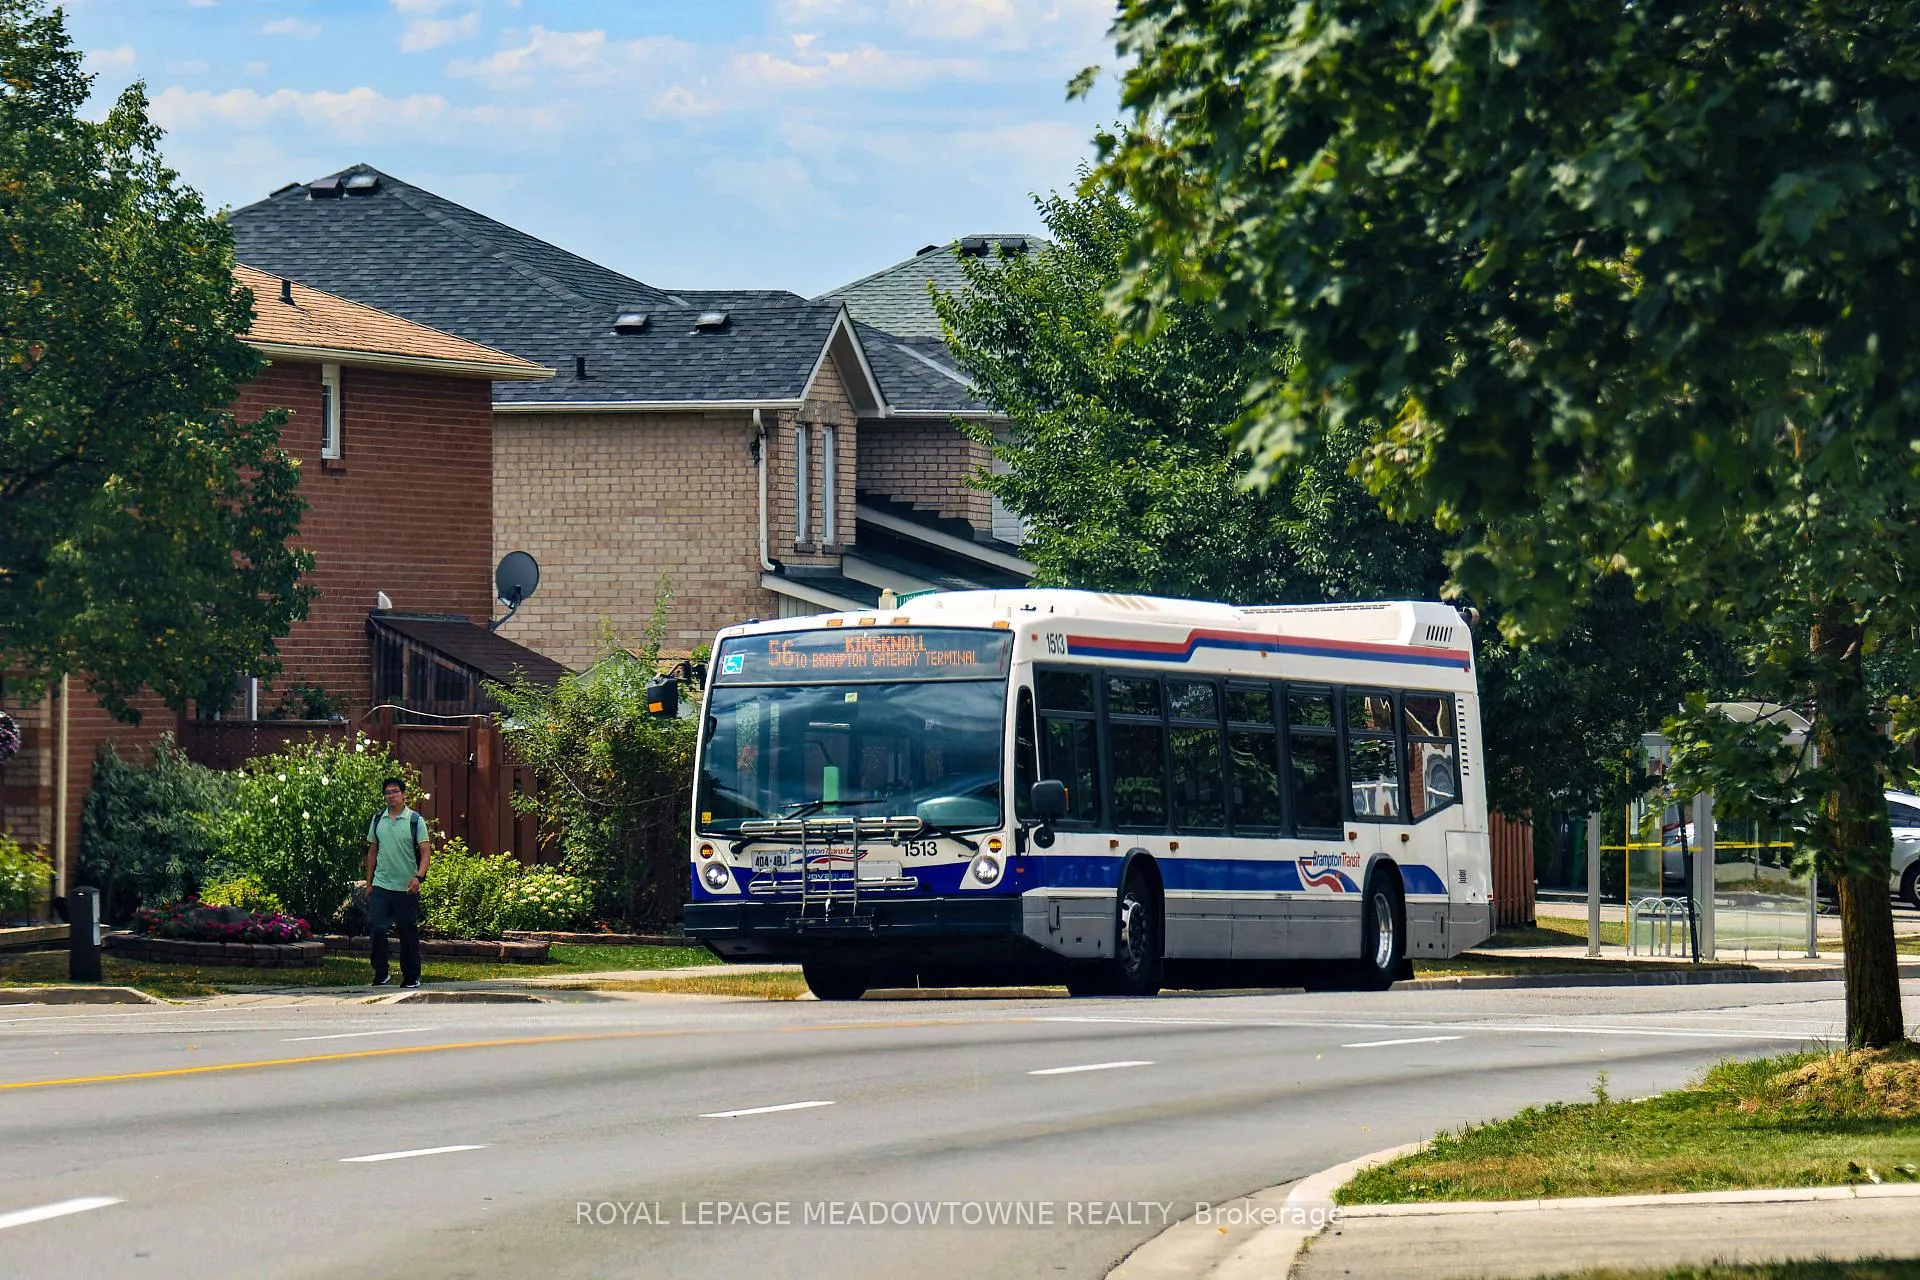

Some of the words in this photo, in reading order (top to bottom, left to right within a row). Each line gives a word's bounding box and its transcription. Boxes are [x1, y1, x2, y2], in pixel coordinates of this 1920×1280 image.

[845, 635, 926, 653] KINGKNOLL
[1046, 632, 1065, 654] 1513
[768, 639, 794, 666] 56
[796, 652, 807, 668] TO
[812, 652, 867, 667] BRAMPTON
[872, 650, 920, 667] GATEWAY
[926, 650, 978, 666] TERMINAL
[905, 841, 938, 857] 1513
